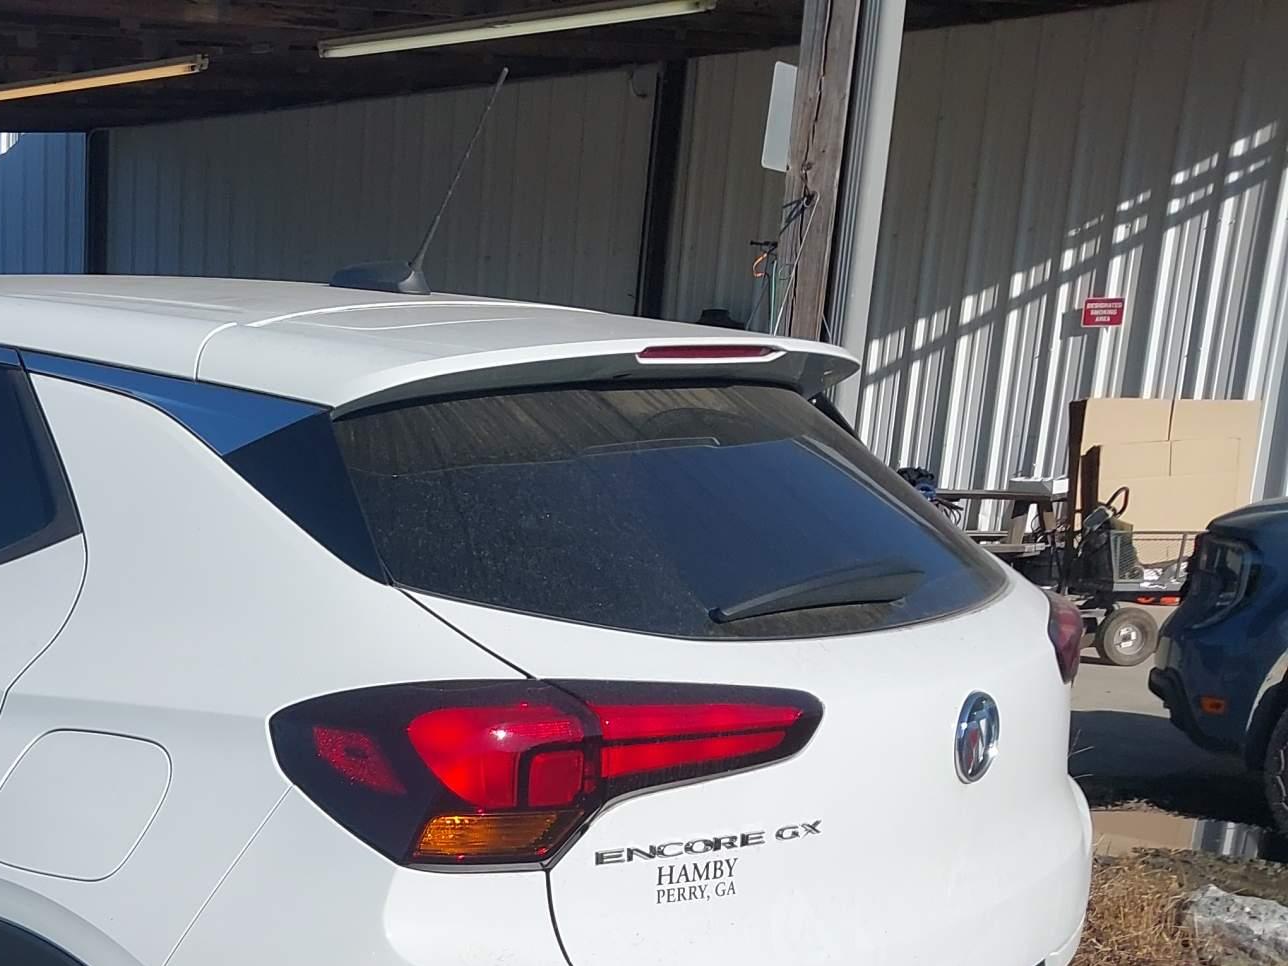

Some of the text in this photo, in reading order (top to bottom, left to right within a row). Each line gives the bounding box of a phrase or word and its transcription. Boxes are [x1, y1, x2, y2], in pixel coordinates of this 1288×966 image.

[595, 820, 822, 866] ENCORE GX
[656, 857, 739, 886] HAMBY
[656, 881, 736, 904] PERRY, GA
